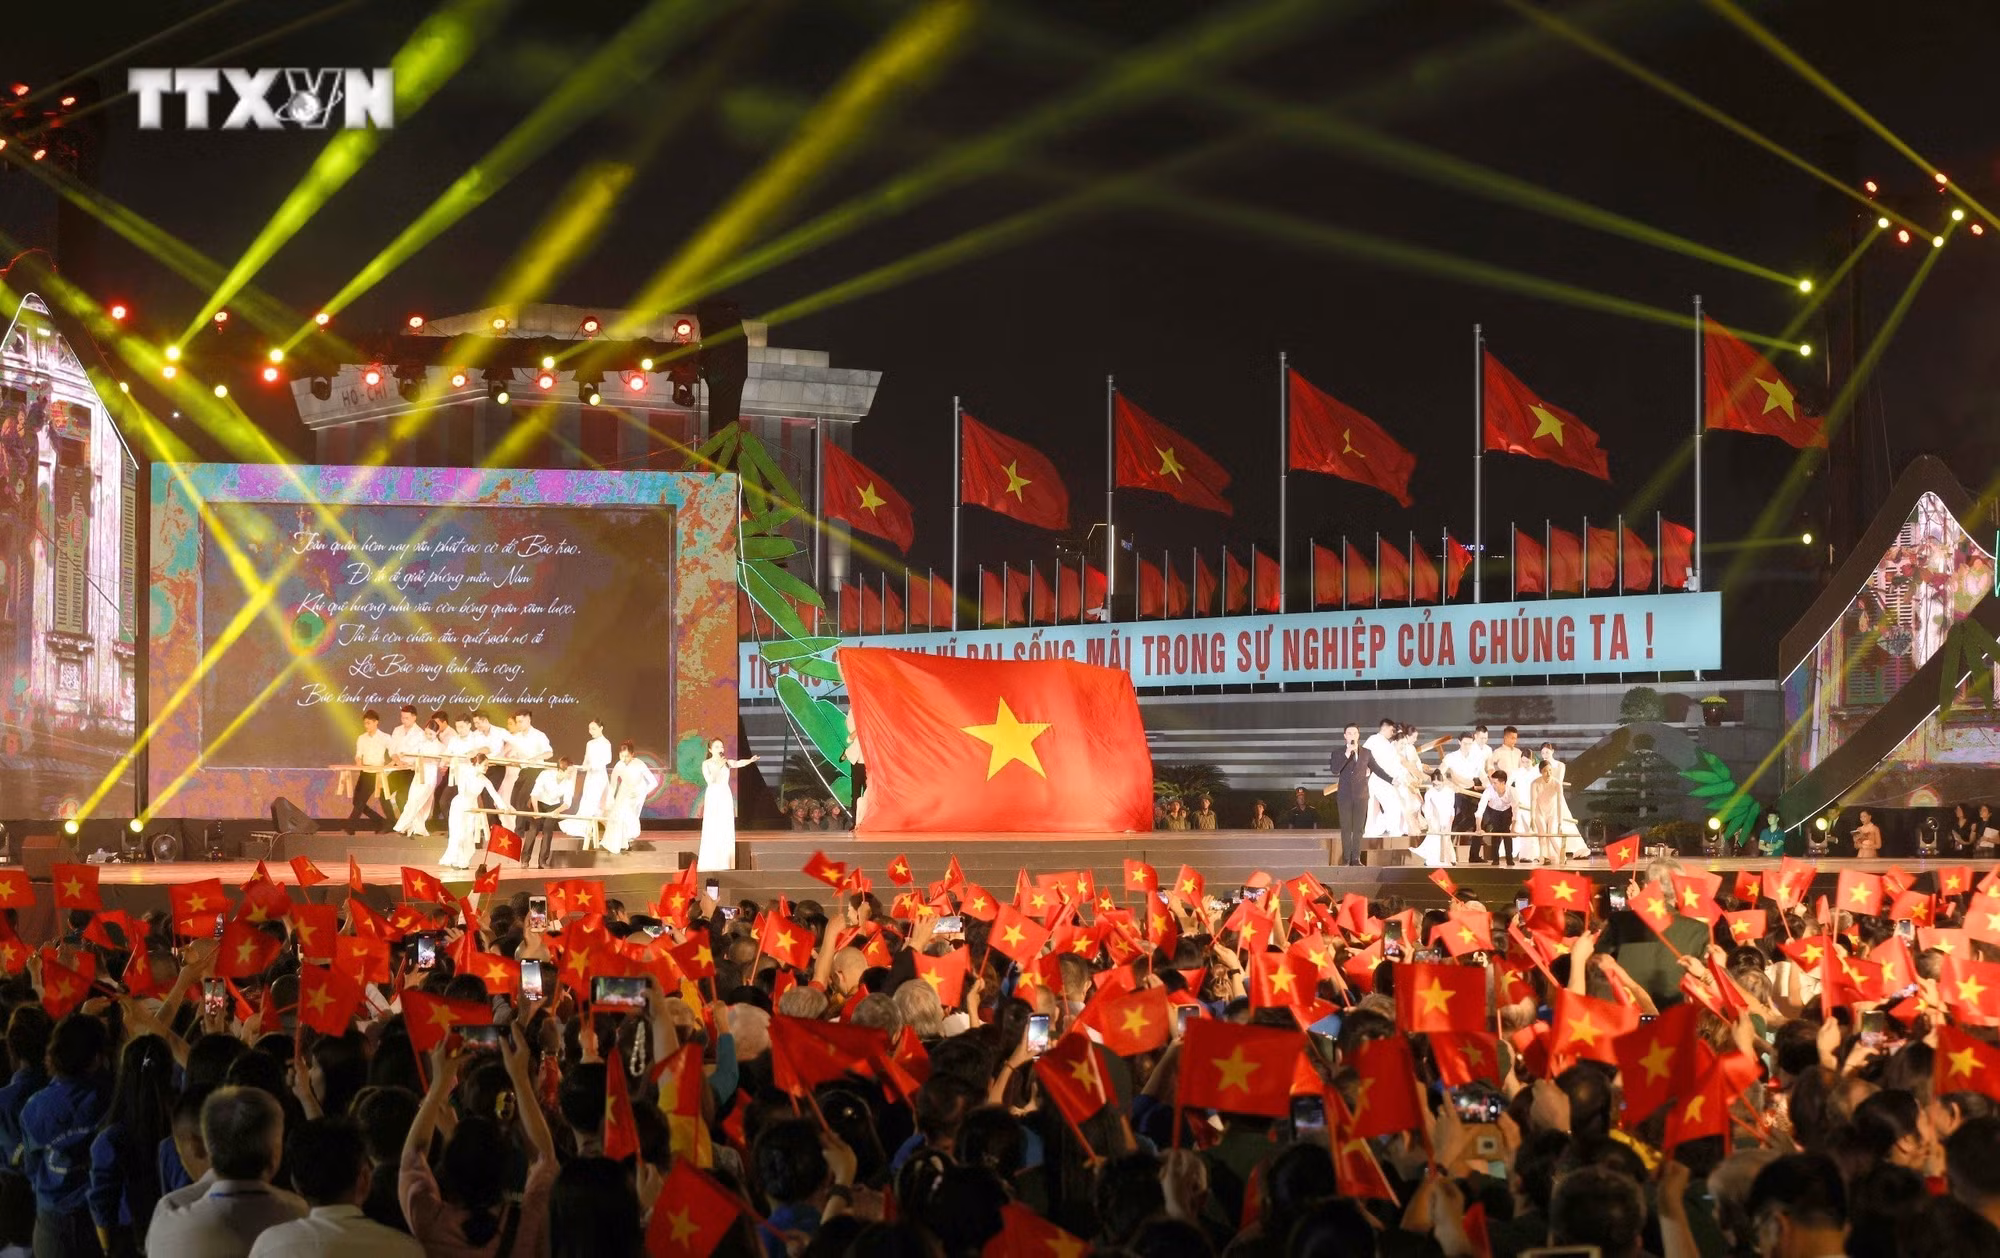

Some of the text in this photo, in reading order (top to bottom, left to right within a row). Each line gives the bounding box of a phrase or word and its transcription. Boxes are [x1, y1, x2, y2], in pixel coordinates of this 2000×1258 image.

[361, 534, 386, 552] hôm
[387, 543, 410, 560] nay
[461, 543, 482, 554] cao
[517, 534, 554, 558] Bác
[347, 562, 373, 585] Đi
[396, 569, 427, 590] giải
[423, 566, 465, 591] phóng
[493, 564, 532, 588] Nam
[296, 592, 326, 618] Khi
[459, 596, 489, 621] bóng
[1086, 629, 1132, 672] MÃI
[1143, 634, 1225, 676] TRONG
[1236, 624, 1275, 681] SỰ
[1282, 616, 1386, 678] NGHIỆP
[1397, 608, 1456, 668] CỦA
[1468, 606, 1576, 666] CHÚNG
[1589, 613, 1630, 661] TA
[376, 653, 414, 678] Bác
[415, 664, 444, 682] vang
[296, 683, 334, 708] Bác
